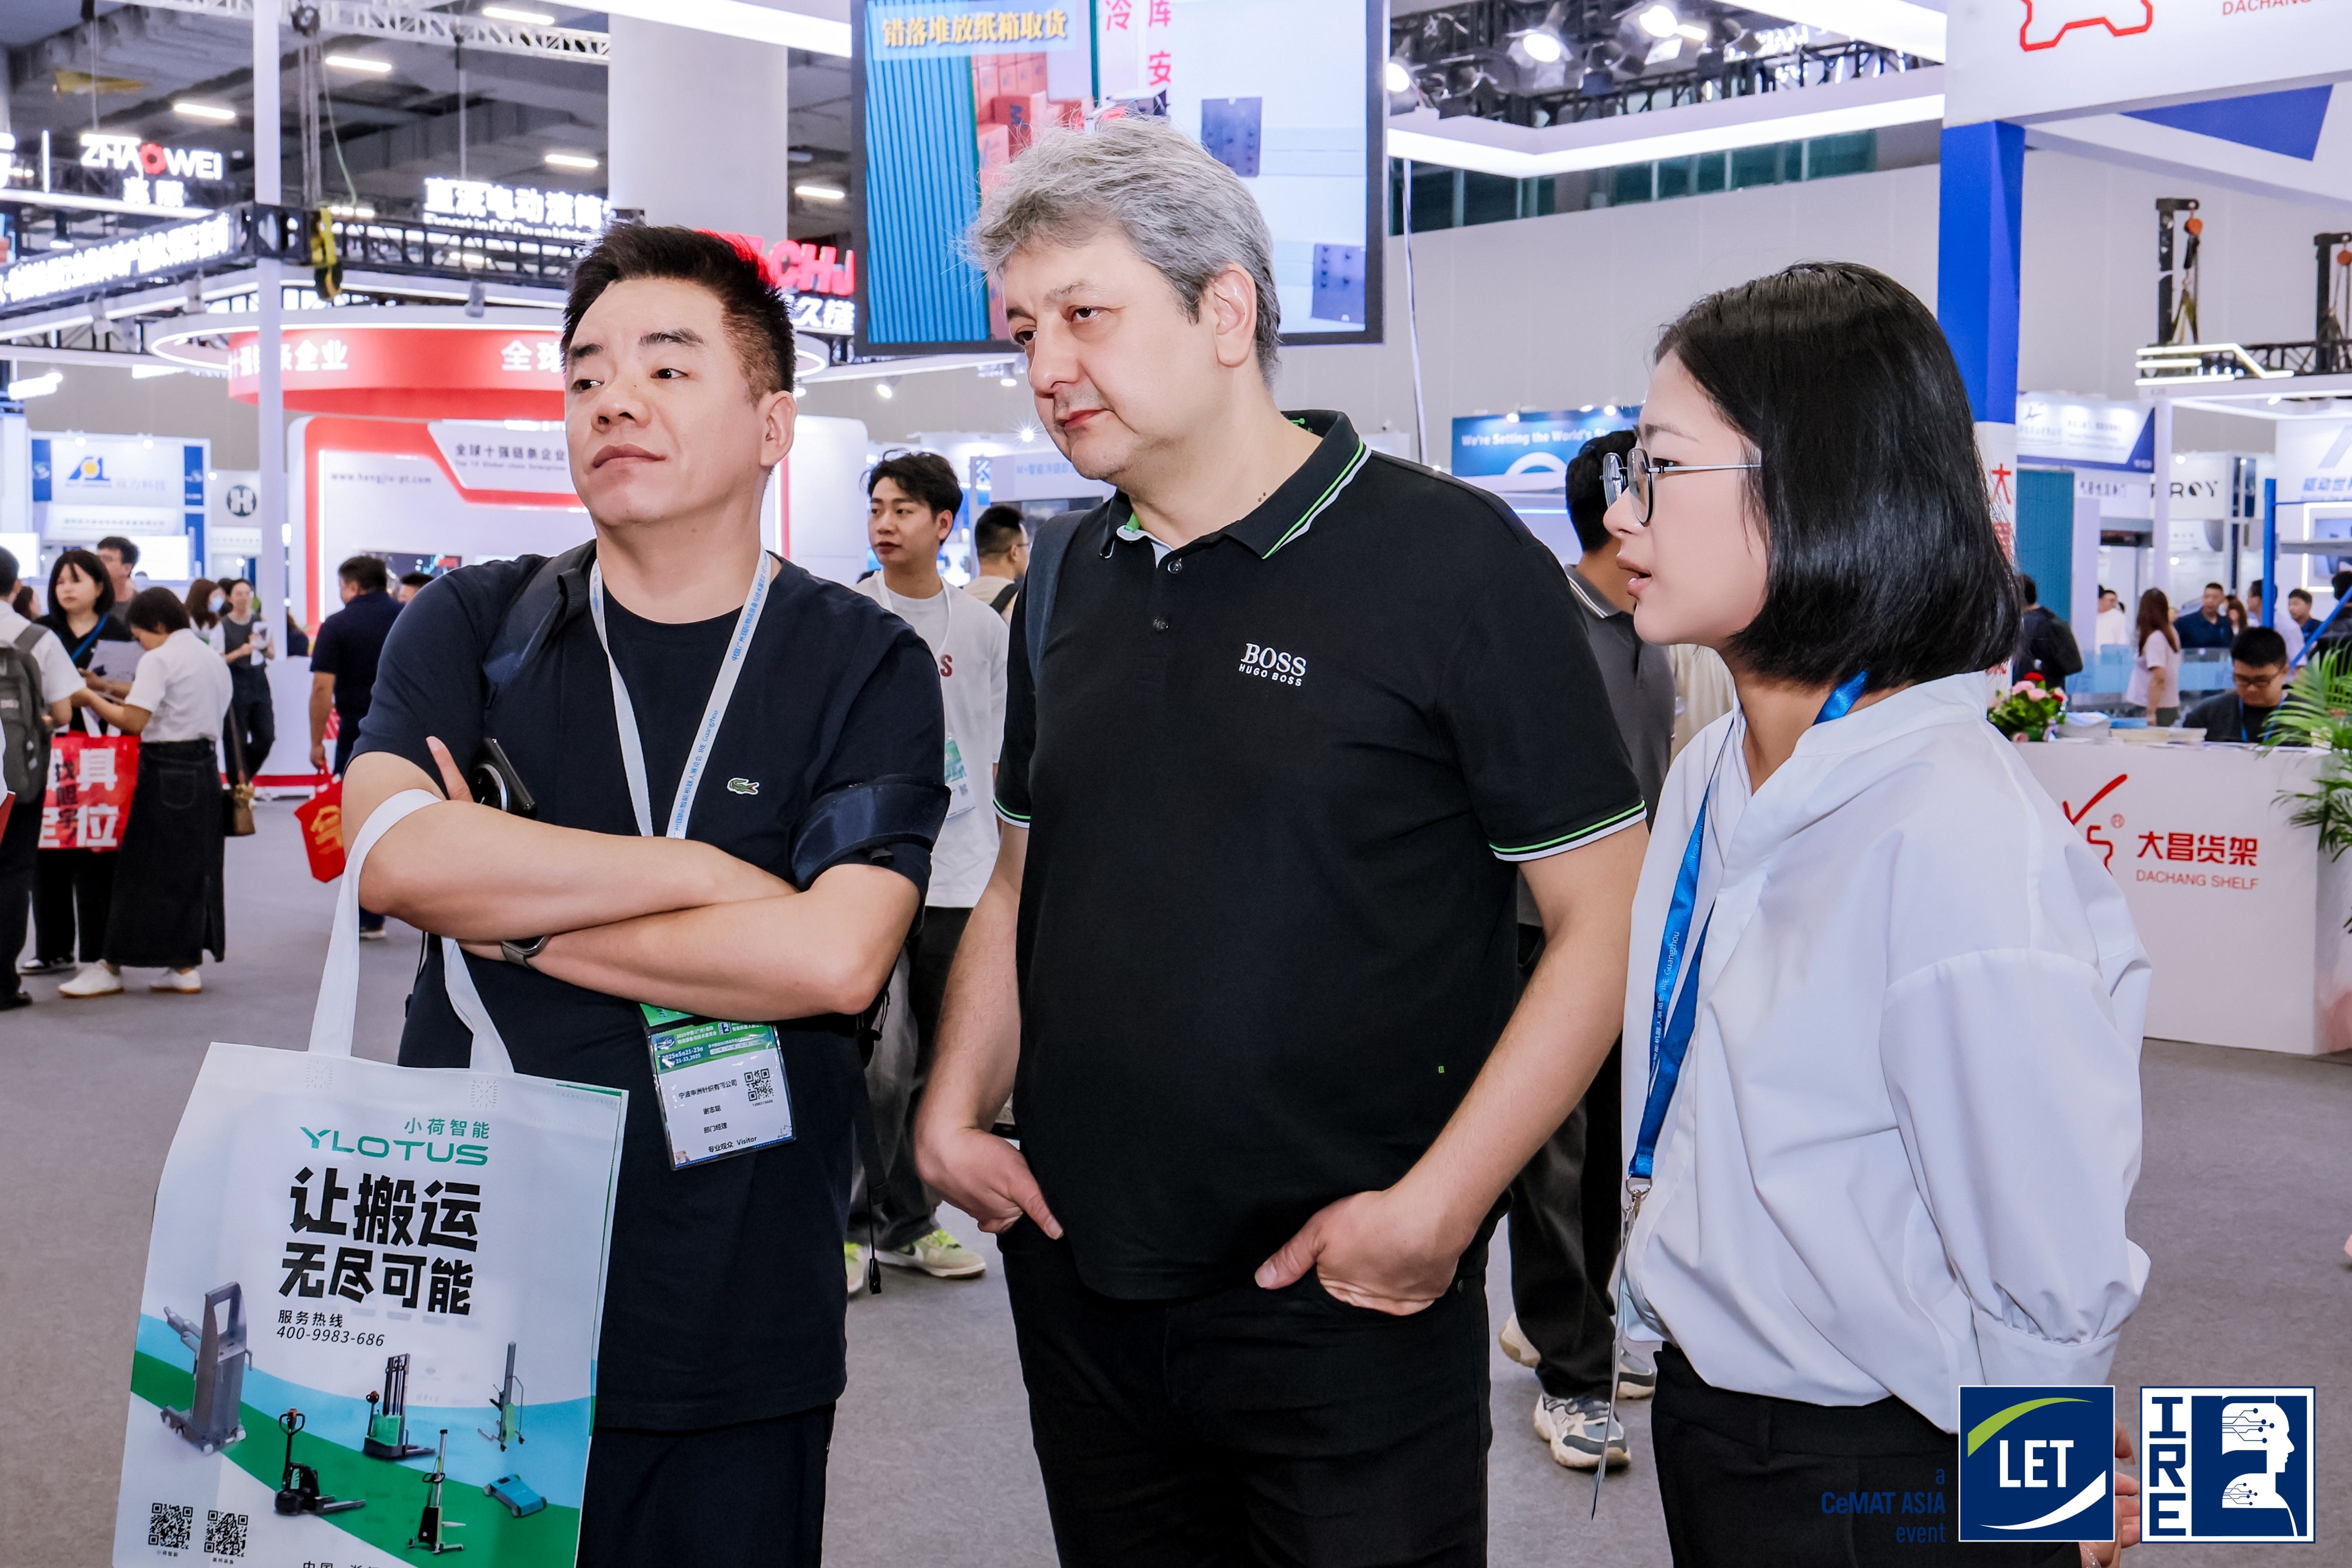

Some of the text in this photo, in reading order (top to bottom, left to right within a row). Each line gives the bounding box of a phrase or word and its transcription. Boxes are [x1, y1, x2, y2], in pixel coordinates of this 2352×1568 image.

[883, 9, 1067, 47] 错落堆放纸箱取货
[81, 142, 223, 180] ZHAOWEI
[1492, 433, 1530, 446] Setting
[1532, 431, 1549, 443] the
[1551, 429, 1592, 441] World's
[1239, 663, 1302, 687] HUGO BOSS
[1241, 643, 1307, 677] BOSS
[702, 710, 718, 741] Guangzhou
[2137, 831, 2258, 866] 大昌货架
[2136, 869, 2259, 890] DACHANG SHELF
[1664, 931, 1680, 975] Guangzhou
[404, 1117, 490, 1139] 小荷智能
[703, 1122, 728, 1134] 部门经理
[300, 1126, 489, 1166] YLOTUS
[708, 1136, 757, 1153] 专业观众 Visitor
[290, 1166, 481, 1252] 让搬运
[279, 1242, 474, 1316] 无尽可能
[278, 1309, 343, 1328] 服务热线
[277, 1326, 385, 1346] 400-9983-686
